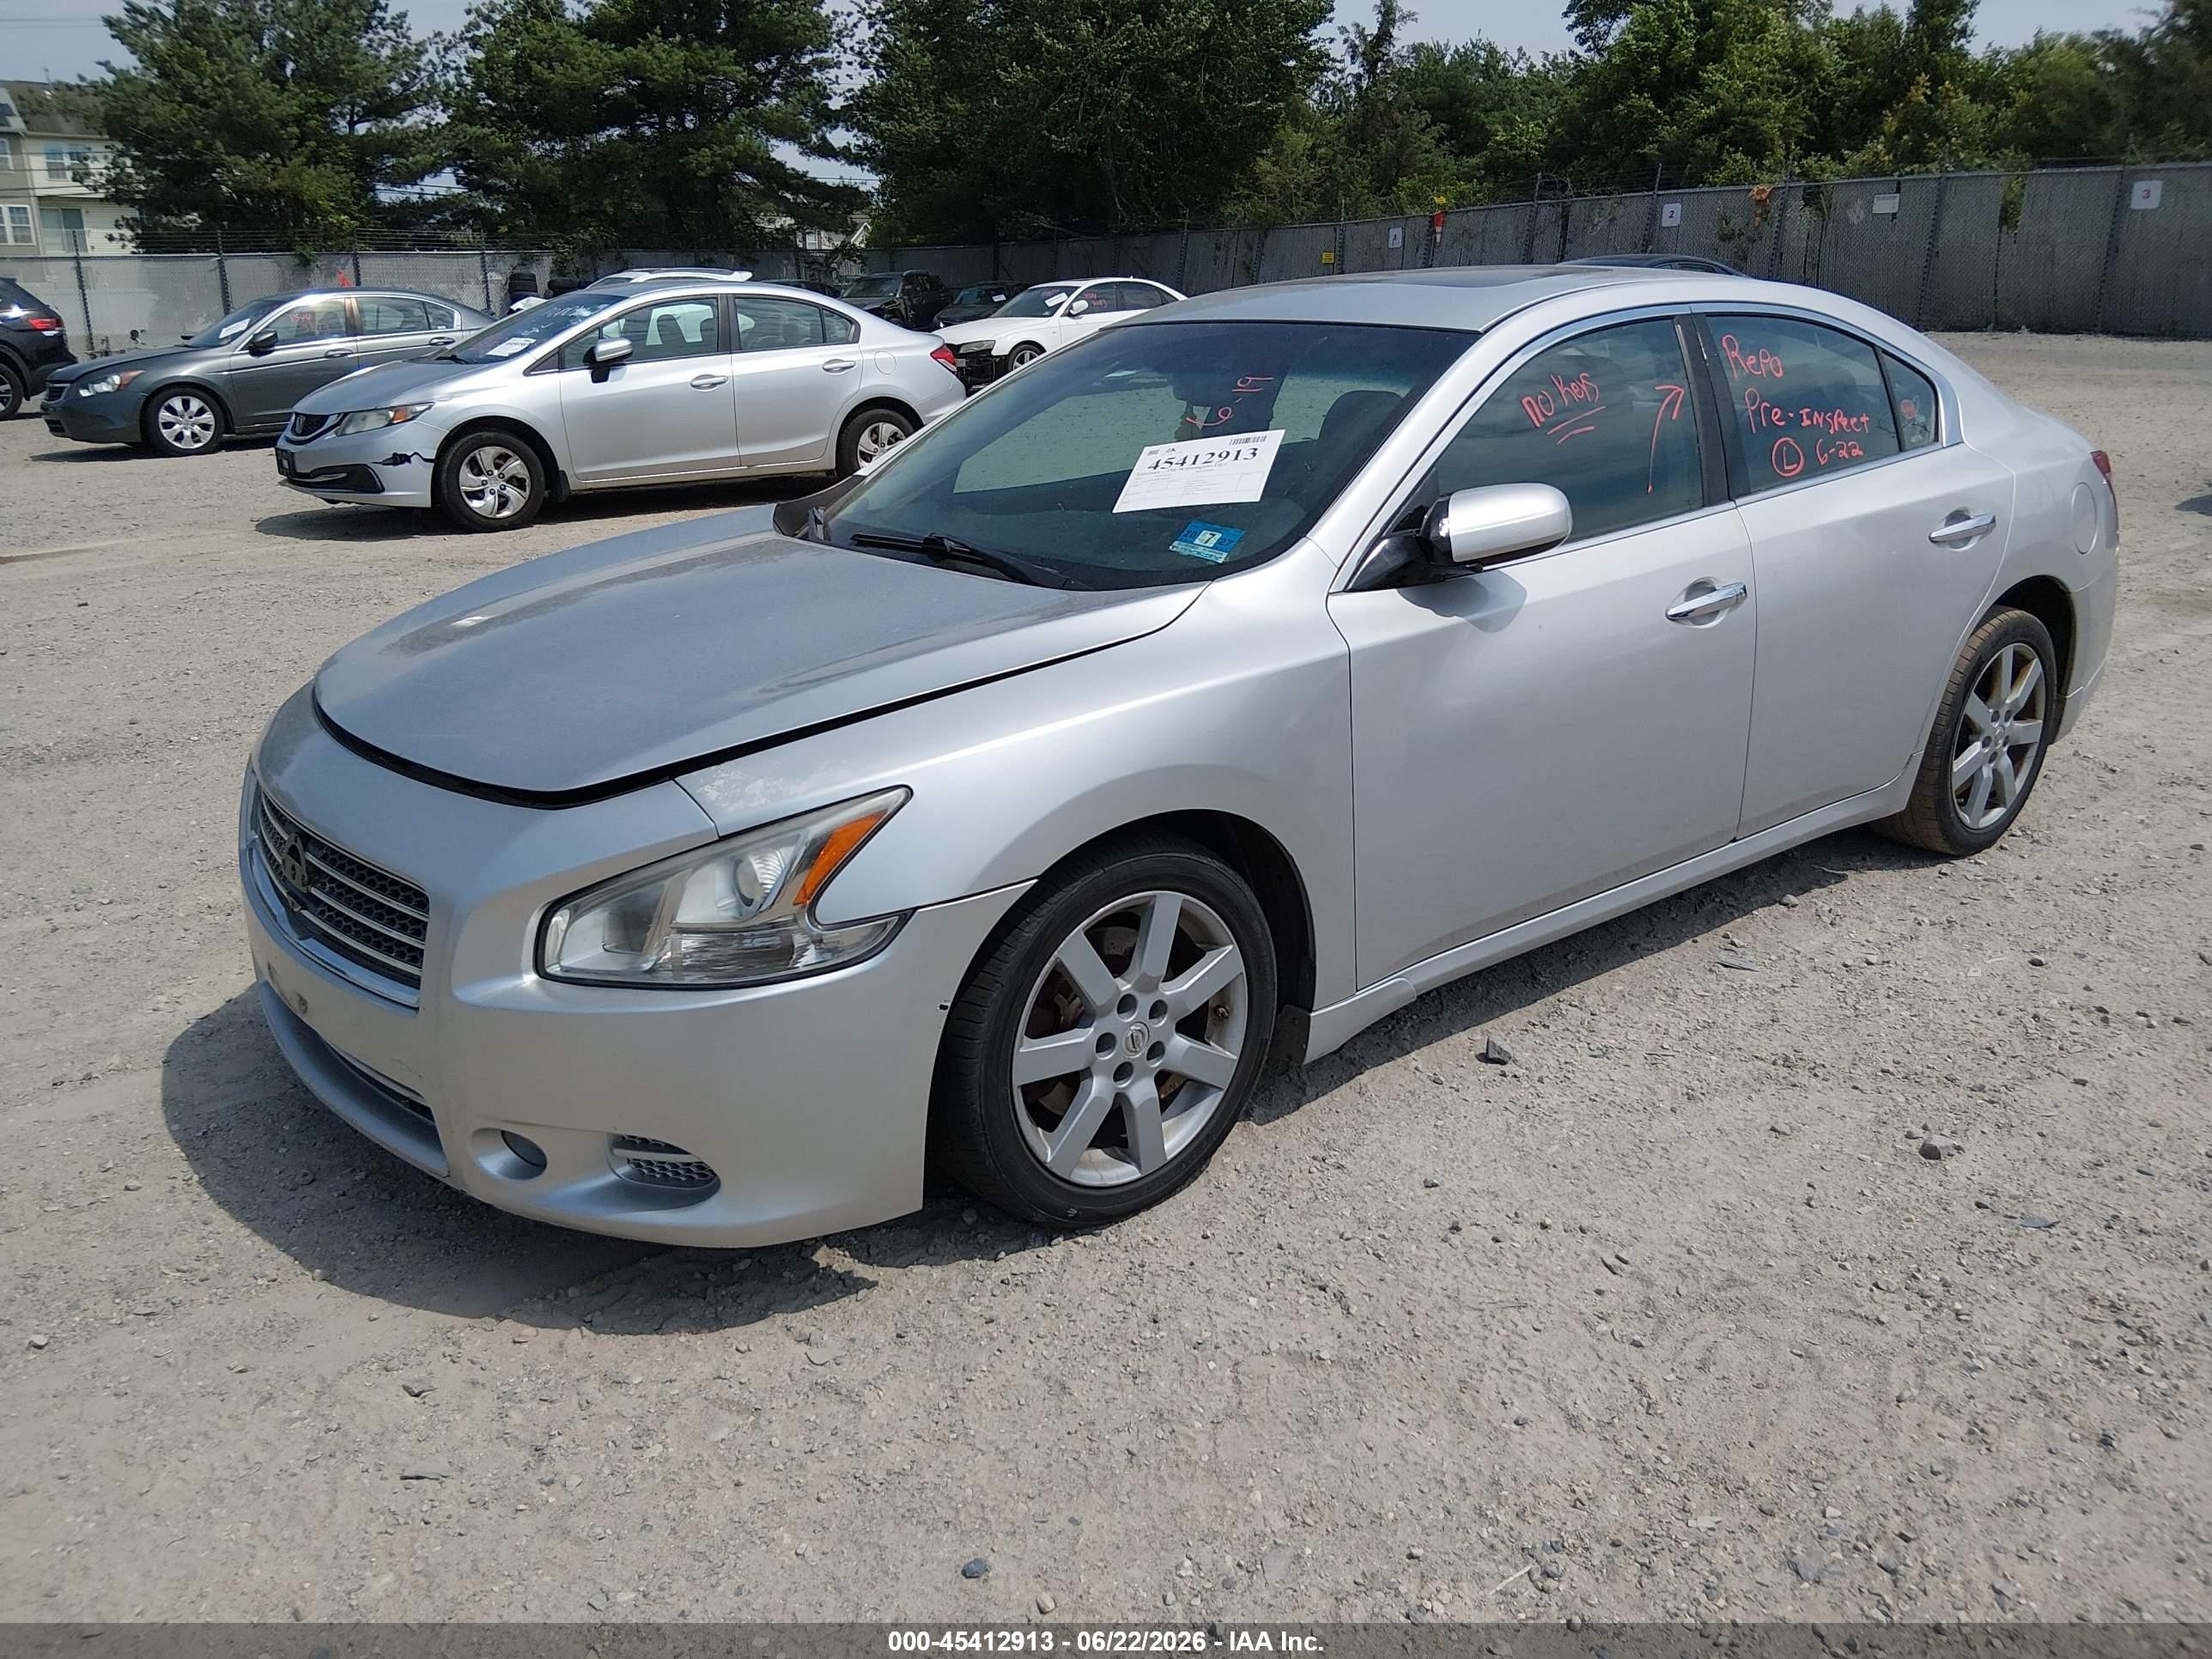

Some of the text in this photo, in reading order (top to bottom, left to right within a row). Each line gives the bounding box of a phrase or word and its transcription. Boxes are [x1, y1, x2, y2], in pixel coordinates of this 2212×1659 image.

[1668, 210, 1675, 219] 2
[1147, 447, 1259, 471] 45412913
[1815, 438, 1863, 466] 6-22
[1204, 532, 1215, 544] 7
